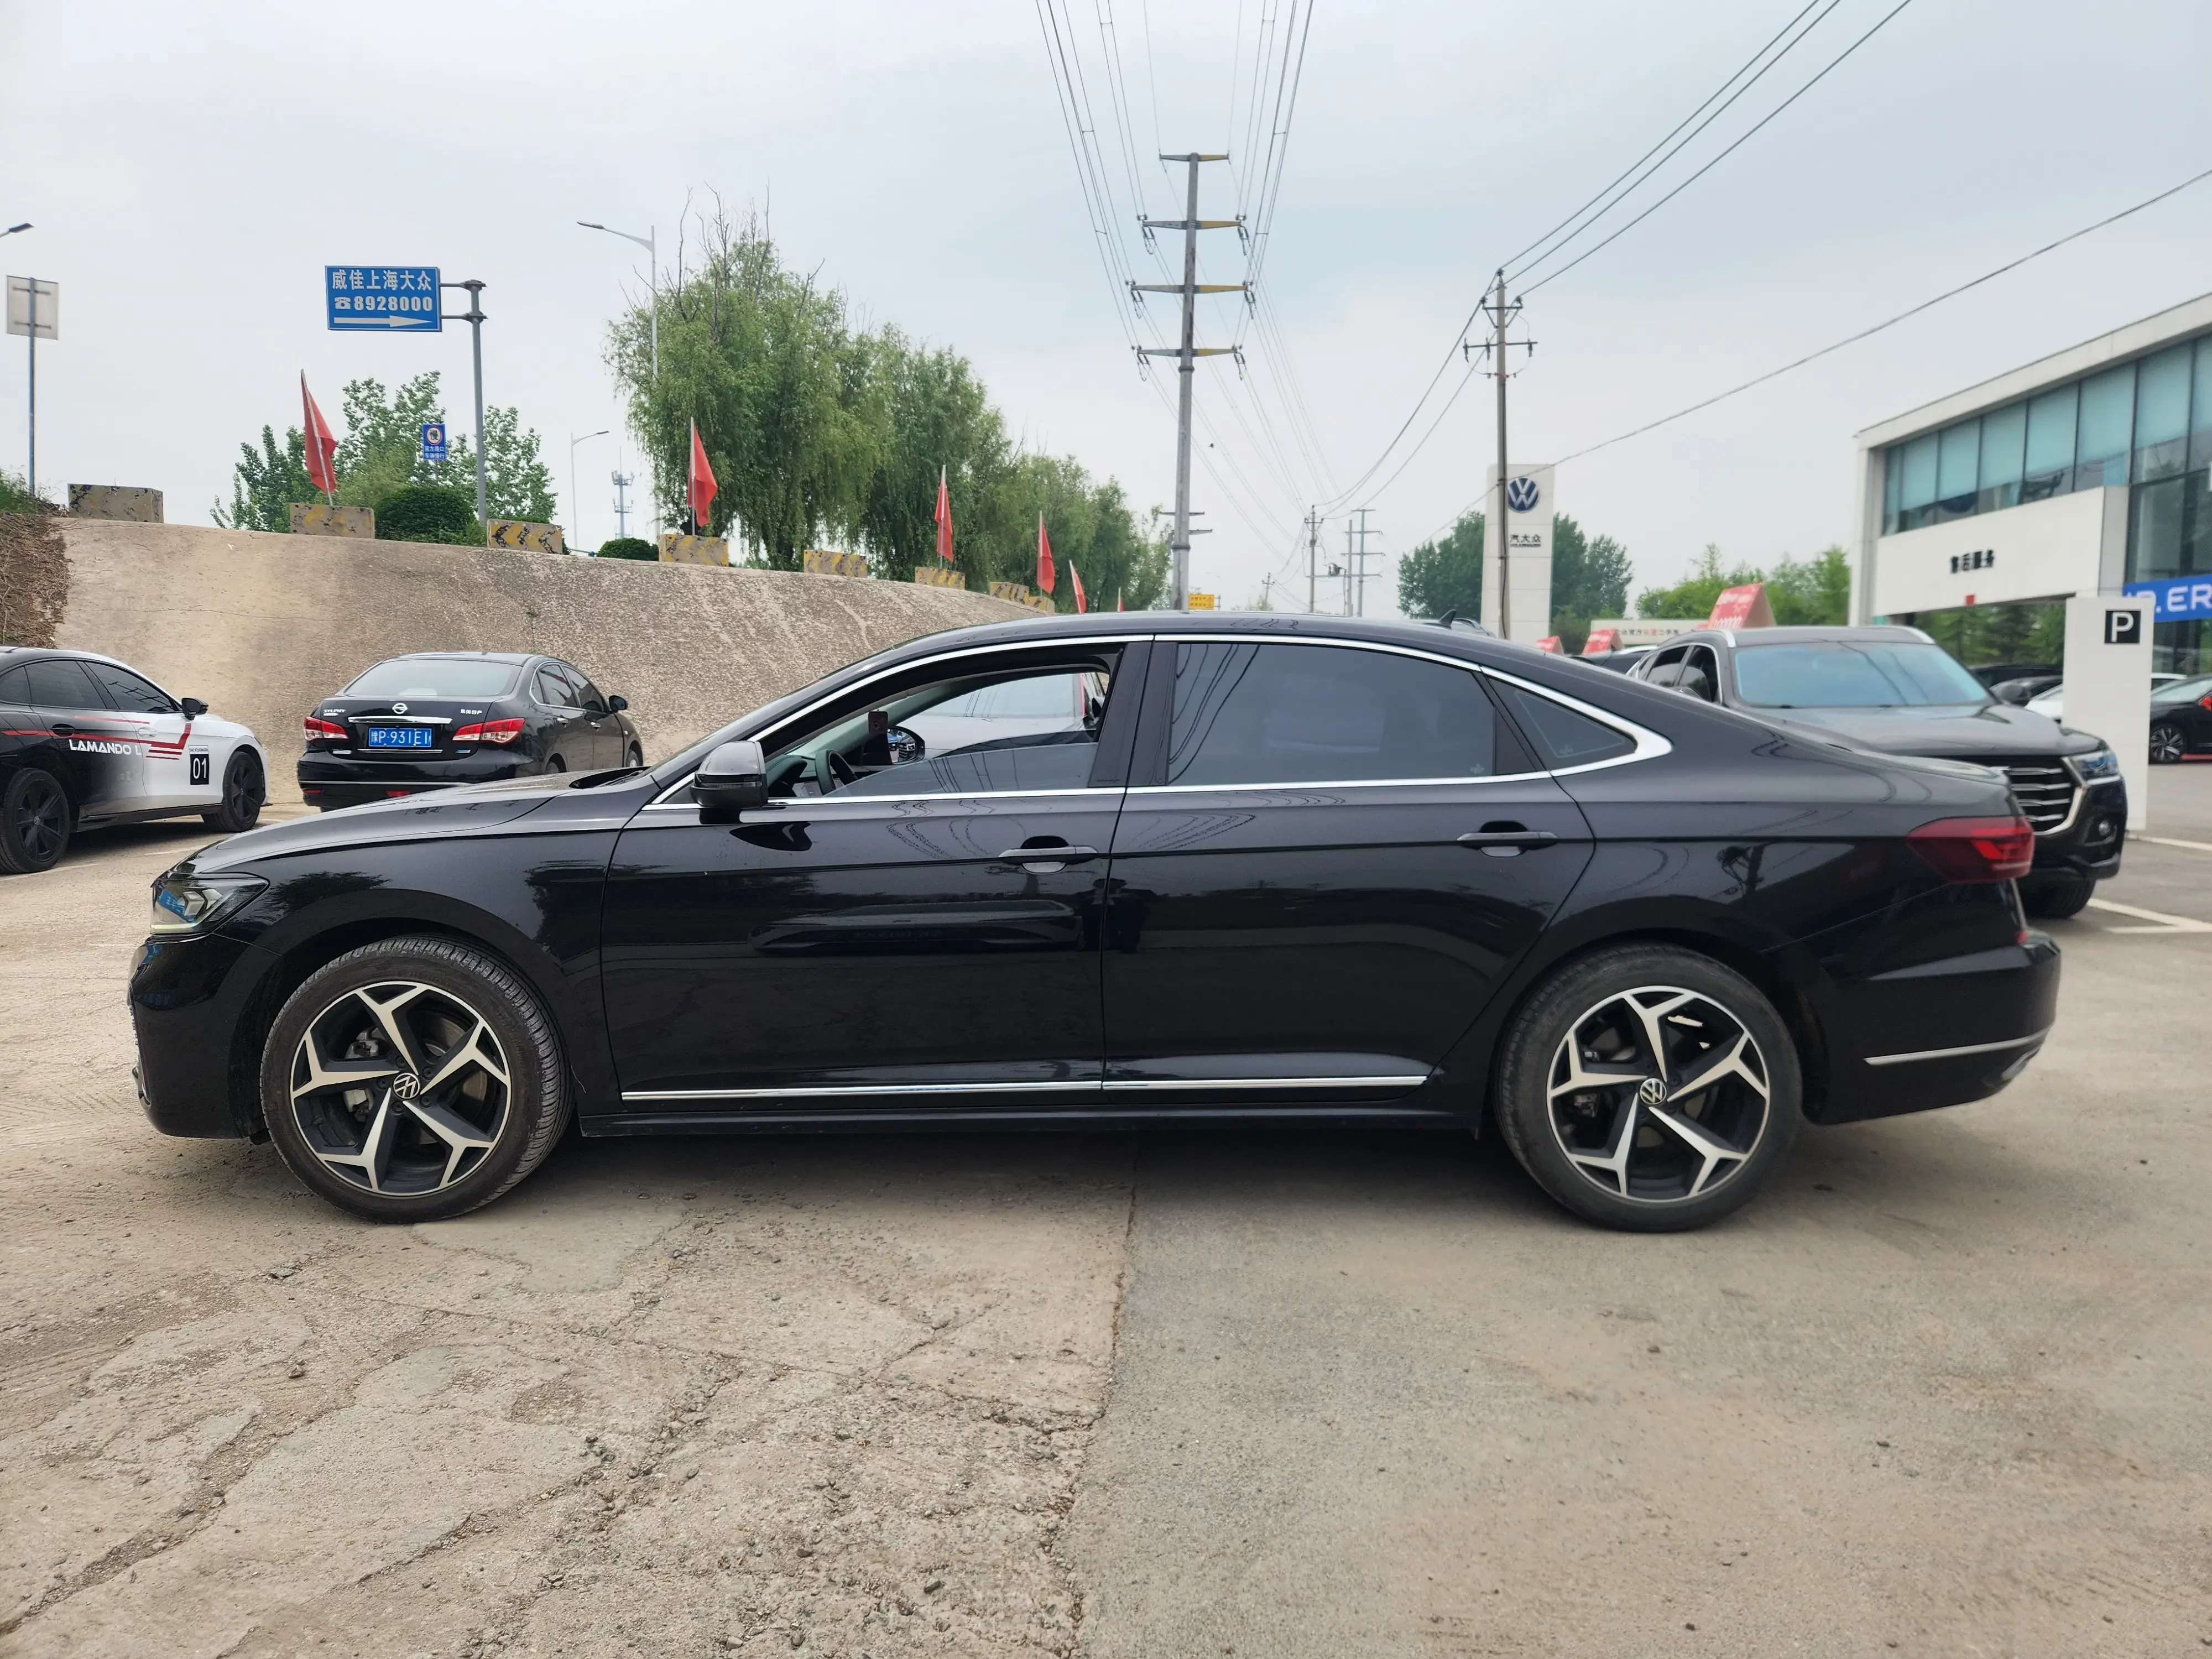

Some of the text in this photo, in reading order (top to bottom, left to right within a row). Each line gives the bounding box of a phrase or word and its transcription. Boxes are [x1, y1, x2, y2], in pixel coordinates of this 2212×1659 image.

[332, 269, 432, 290] 威佳上海大众
[354, 296, 432, 311] 8928000
[429, 430, 439, 441] 慢
[1510, 533, 1541, 542] 汽大众
[2111, 611, 2134, 643] P
[69, 739, 142, 755] LAMANDO L
[193, 758, 206, 779] 01
